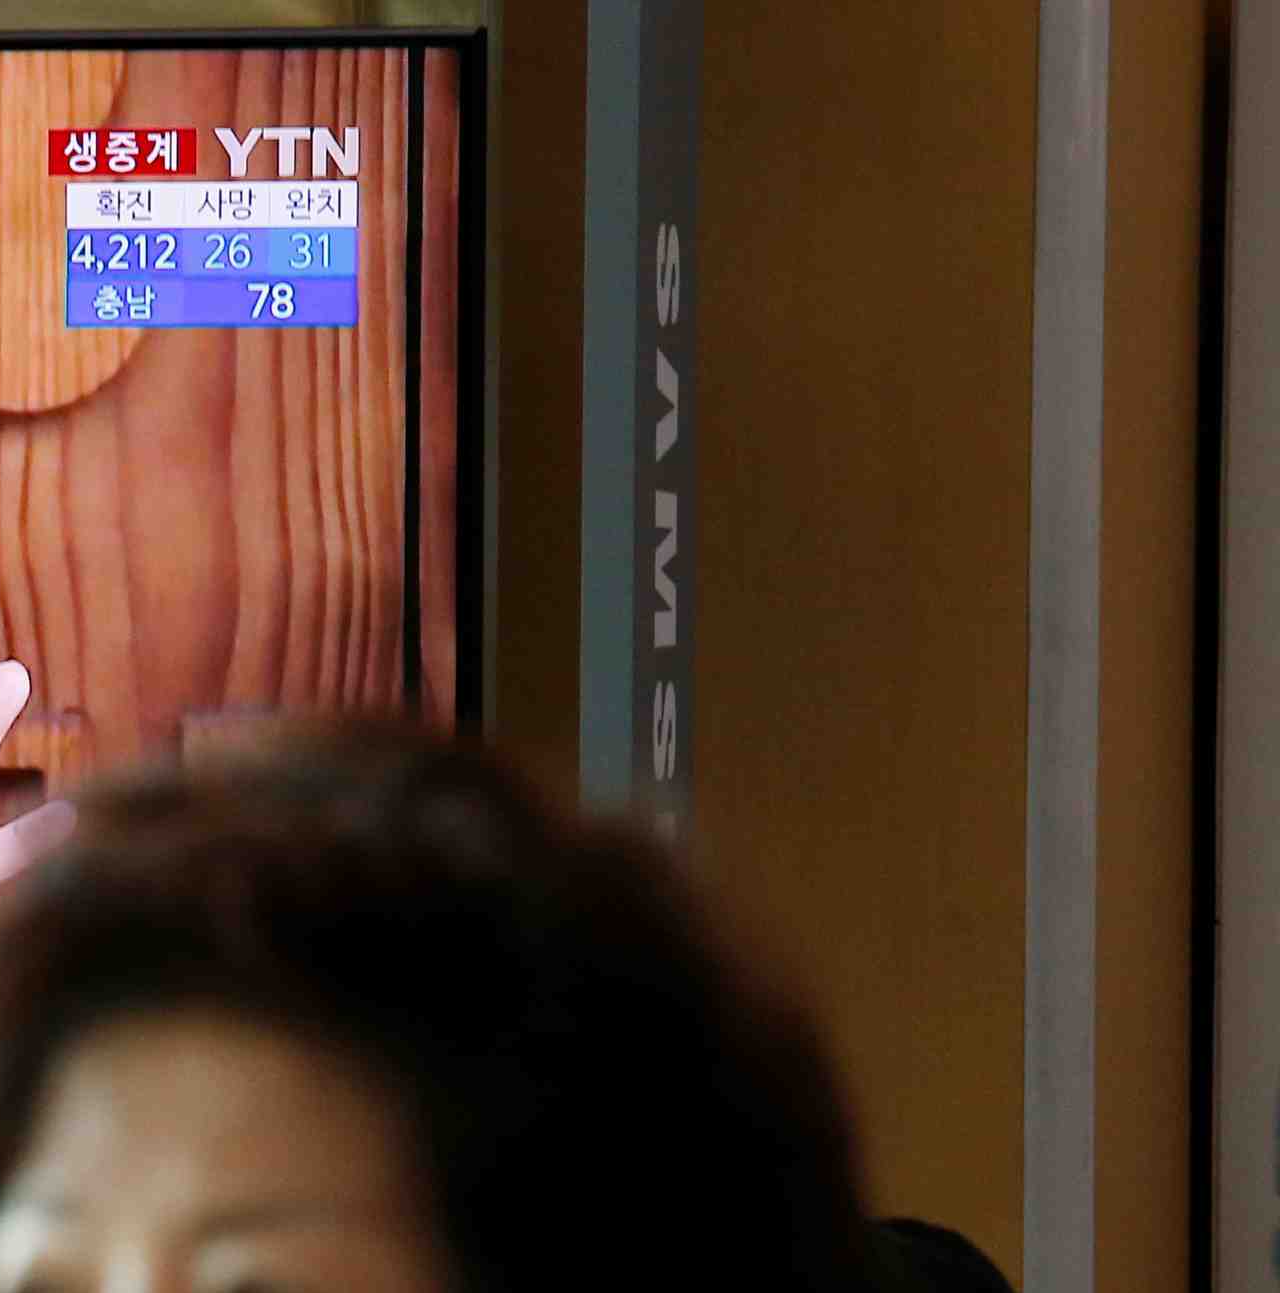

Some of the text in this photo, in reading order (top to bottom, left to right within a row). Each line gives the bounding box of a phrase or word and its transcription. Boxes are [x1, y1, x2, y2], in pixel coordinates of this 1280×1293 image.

[64, 130, 178, 173] 생중계
[214, 127, 360, 177] YTN
[96, 187, 343, 222] 확진 사망 완치
[71, 233, 333, 274] 4,212 26 31
[93, 282, 296, 321] 충남 78
[651, 221, 681, 846] SAMS
